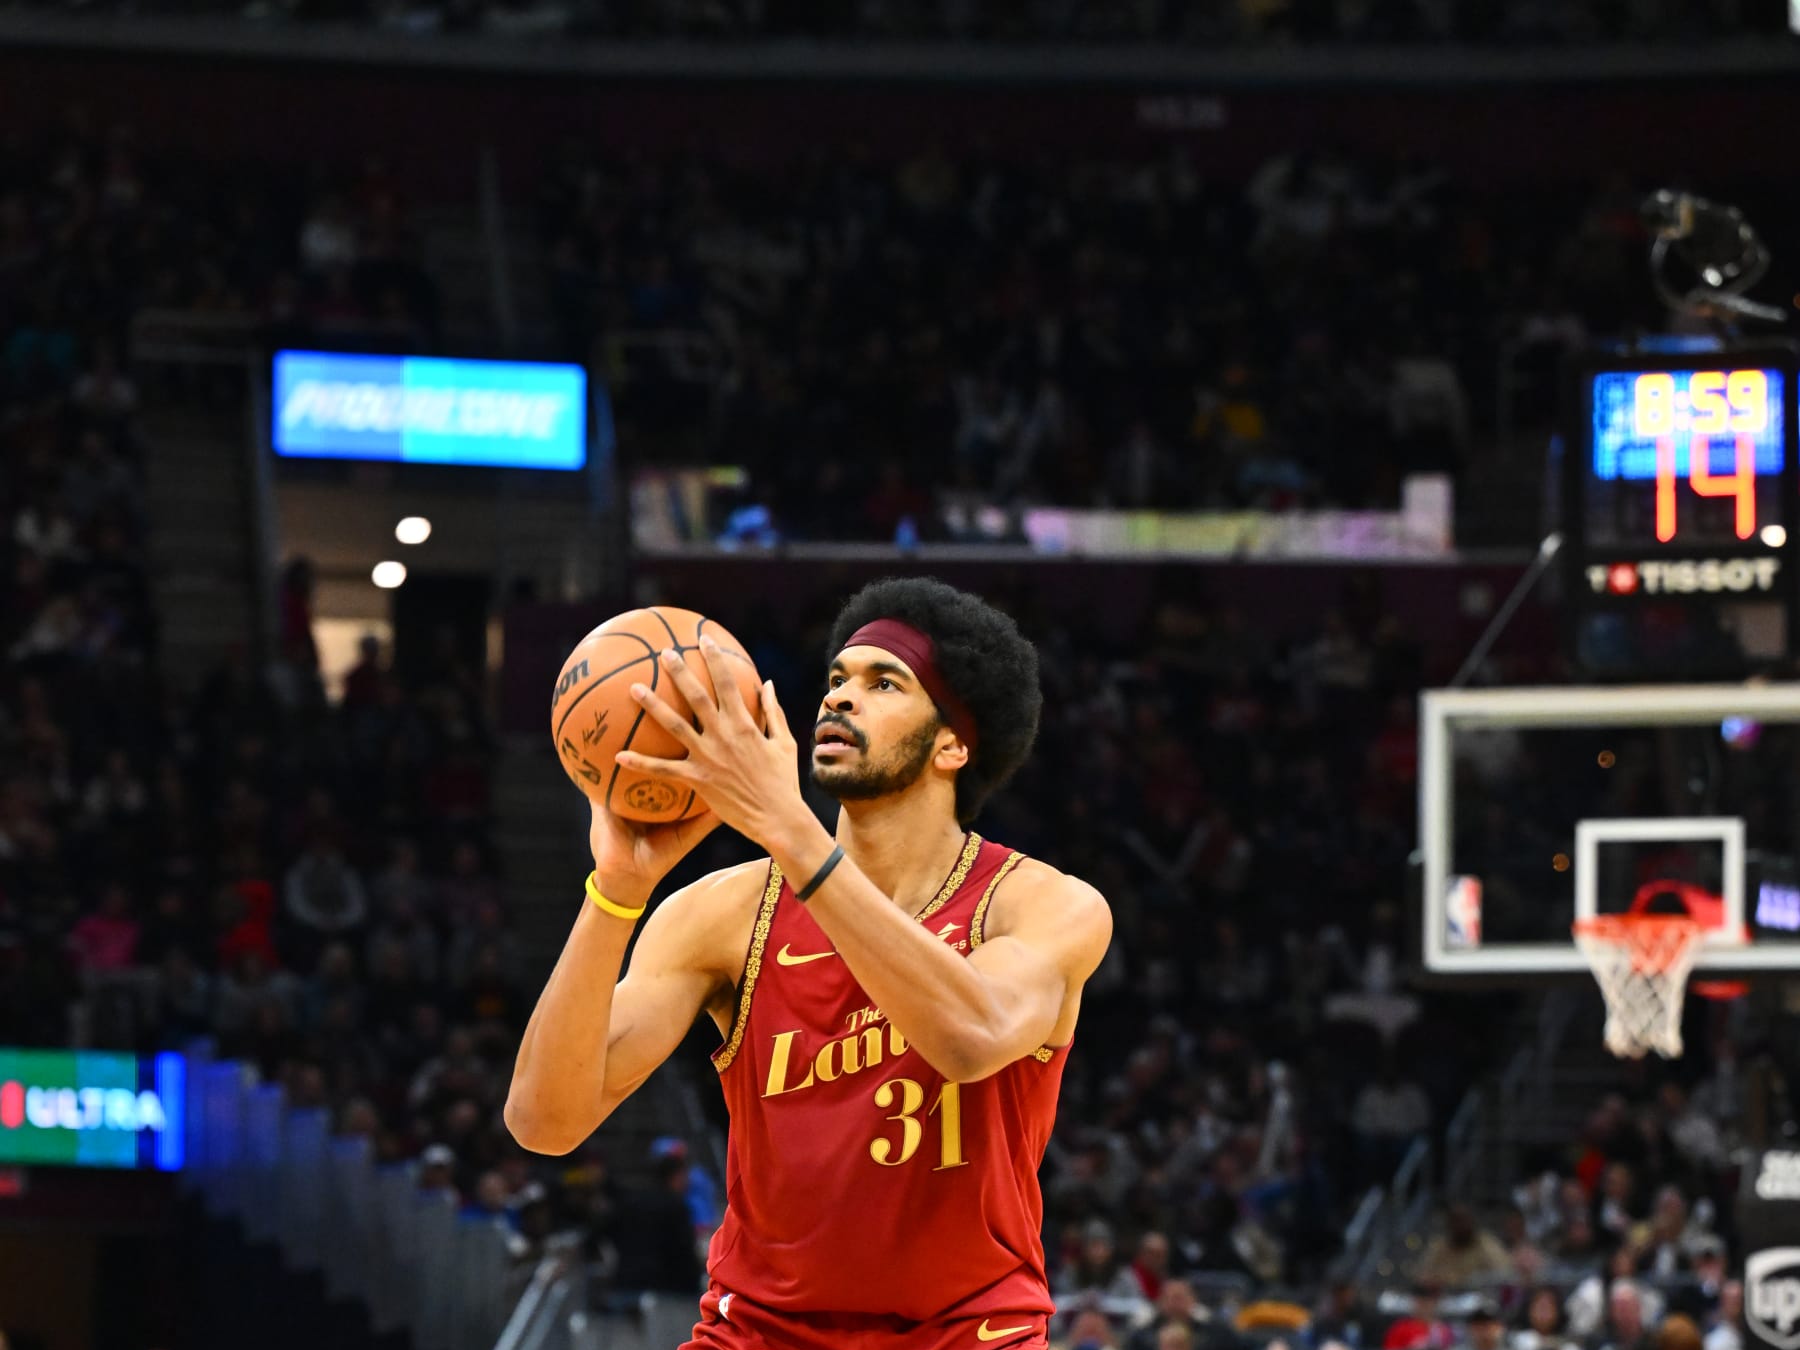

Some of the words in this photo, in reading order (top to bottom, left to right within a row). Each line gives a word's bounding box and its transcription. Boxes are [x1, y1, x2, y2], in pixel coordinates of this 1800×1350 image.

[1634, 369, 1768, 437] 8:59
[1656, 431, 1757, 543] 14
[1638, 557, 1780, 594] TISSOT
[845, 1006, 886, 1034] The
[761, 1019, 911, 1098] Lan
[26, 1086, 167, 1132] ULTRA
[870, 1078, 969, 1172] 31
[1755, 1277, 1800, 1333] up
